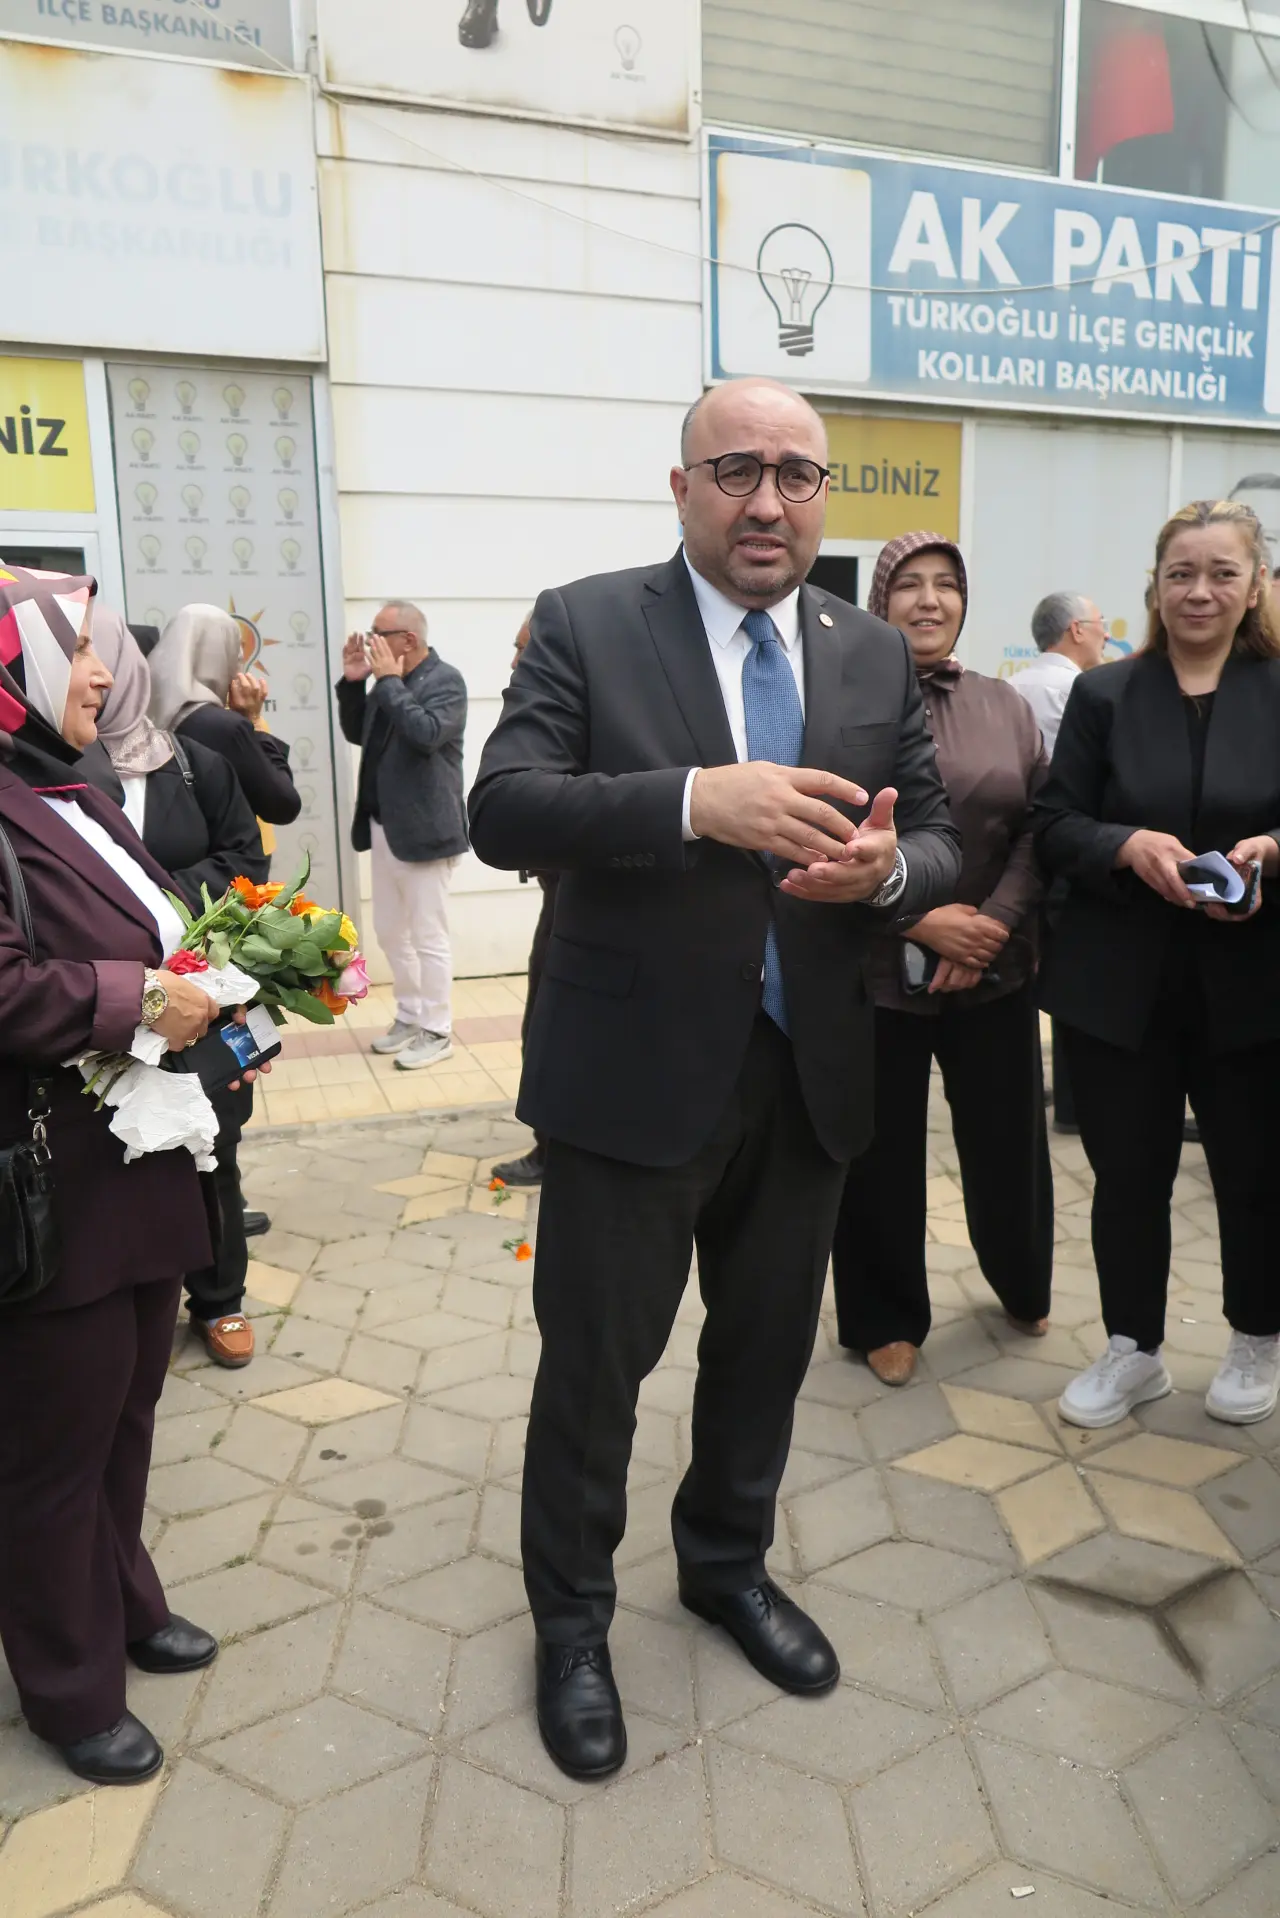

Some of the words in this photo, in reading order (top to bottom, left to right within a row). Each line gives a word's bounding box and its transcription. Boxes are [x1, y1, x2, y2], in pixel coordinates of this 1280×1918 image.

[102, 4, 262, 47] BAŞKANLIĞI
[887, 190, 1021, 287] AK
[887, 291, 1058, 341] TÜRKOĞLU
[1069, 311, 1125, 352] İLÇE
[1135, 320, 1255, 362] GENÇLİK
[918, 349, 1045, 388] KOLLARI
[1056, 359, 1227, 402] BAŞKANLIĞI
[246, 1050, 260, 1060] VISA
